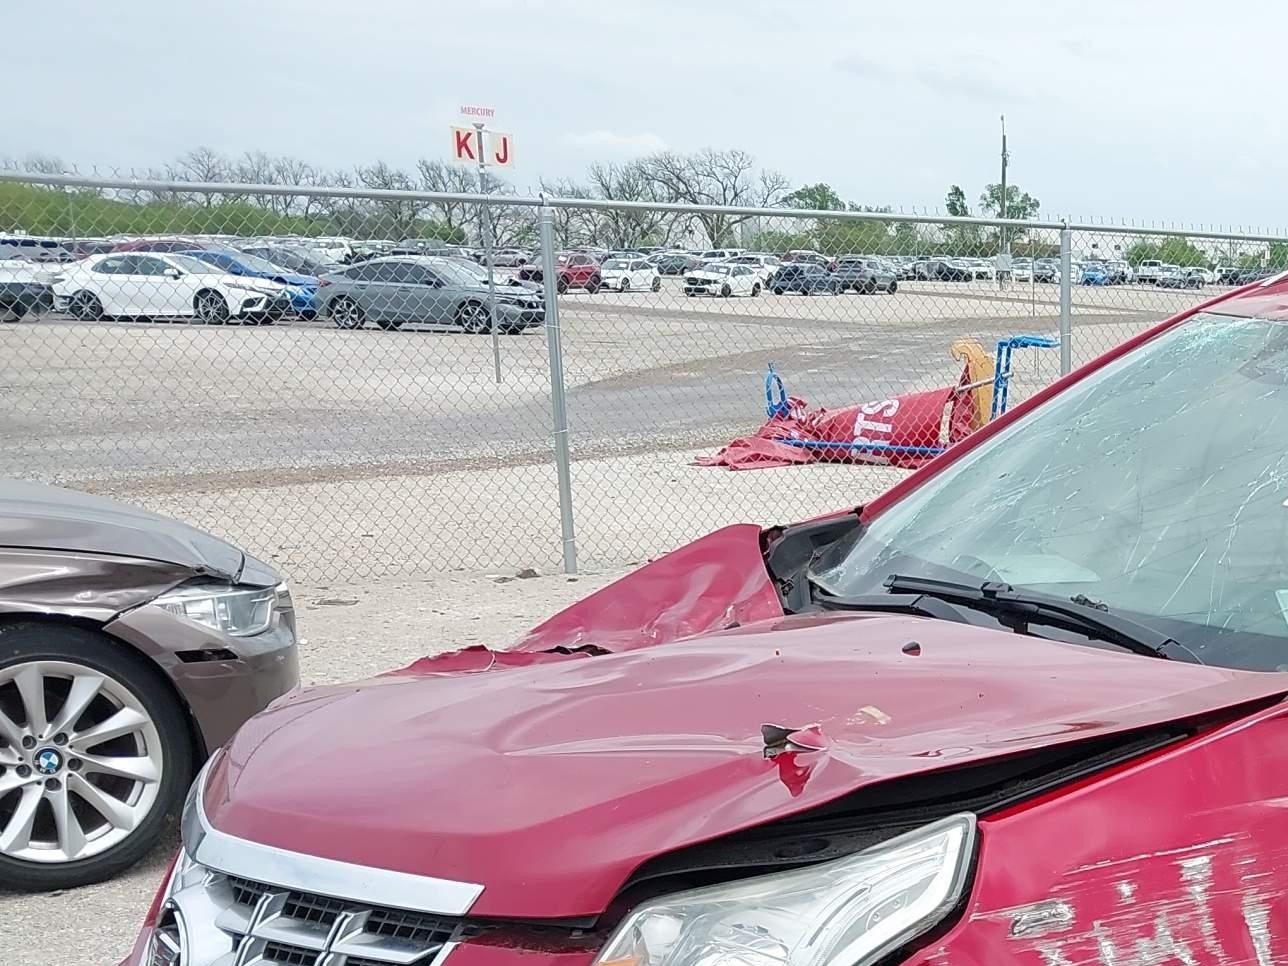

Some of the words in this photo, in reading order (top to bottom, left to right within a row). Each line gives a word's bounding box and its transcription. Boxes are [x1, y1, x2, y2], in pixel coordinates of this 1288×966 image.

[460, 105, 496, 118] MERCURY
[456, 130, 475, 160] K
[495, 136, 508, 164] J
